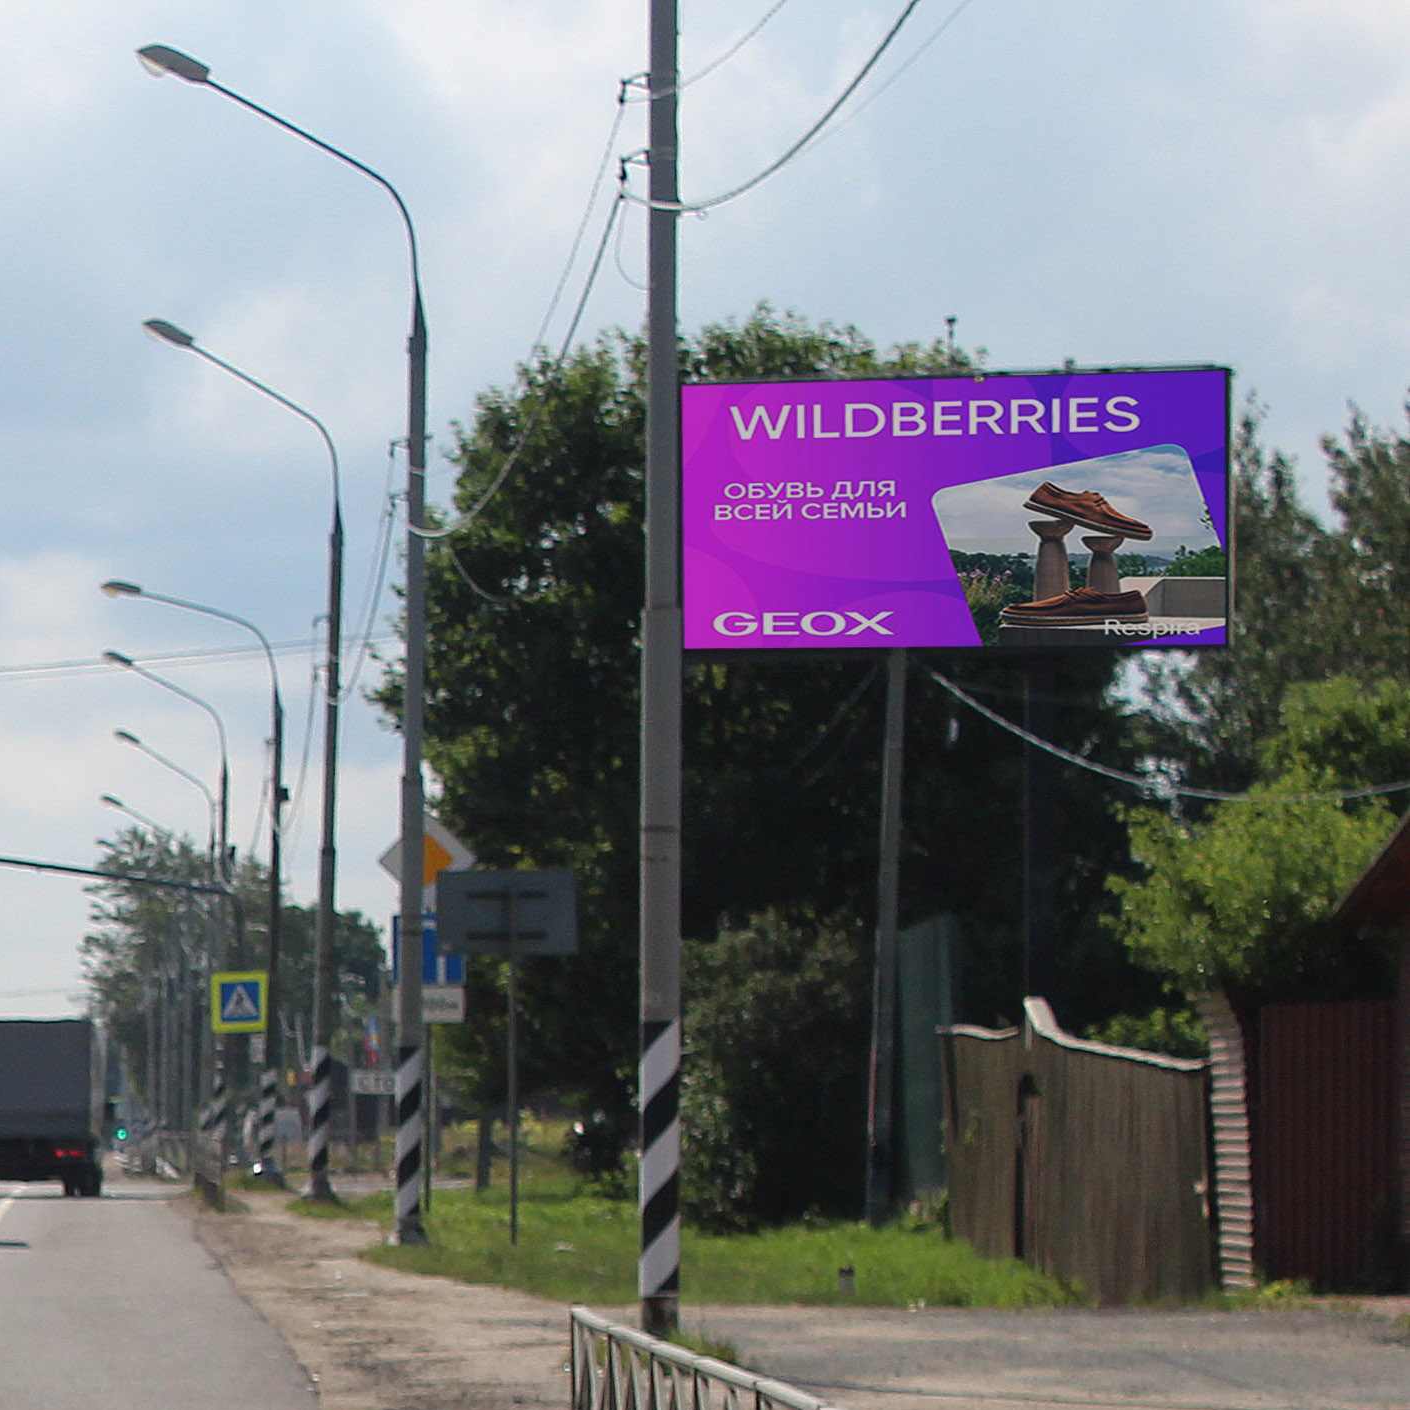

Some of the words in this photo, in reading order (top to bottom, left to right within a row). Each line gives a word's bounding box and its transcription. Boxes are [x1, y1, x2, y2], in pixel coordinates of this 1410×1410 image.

[730, 396, 1140, 440] WILDBERRIES
[723, 482, 824, 500] ОБУВЬ
[831, 480, 897, 500] ДЛЯ
[713, 498, 793, 521] ВСЕЙ
[800, 501, 908, 521] СЕМЬИ
[712, 611, 895, 637] GEOX
[1104, 618, 1201, 640] Respira
